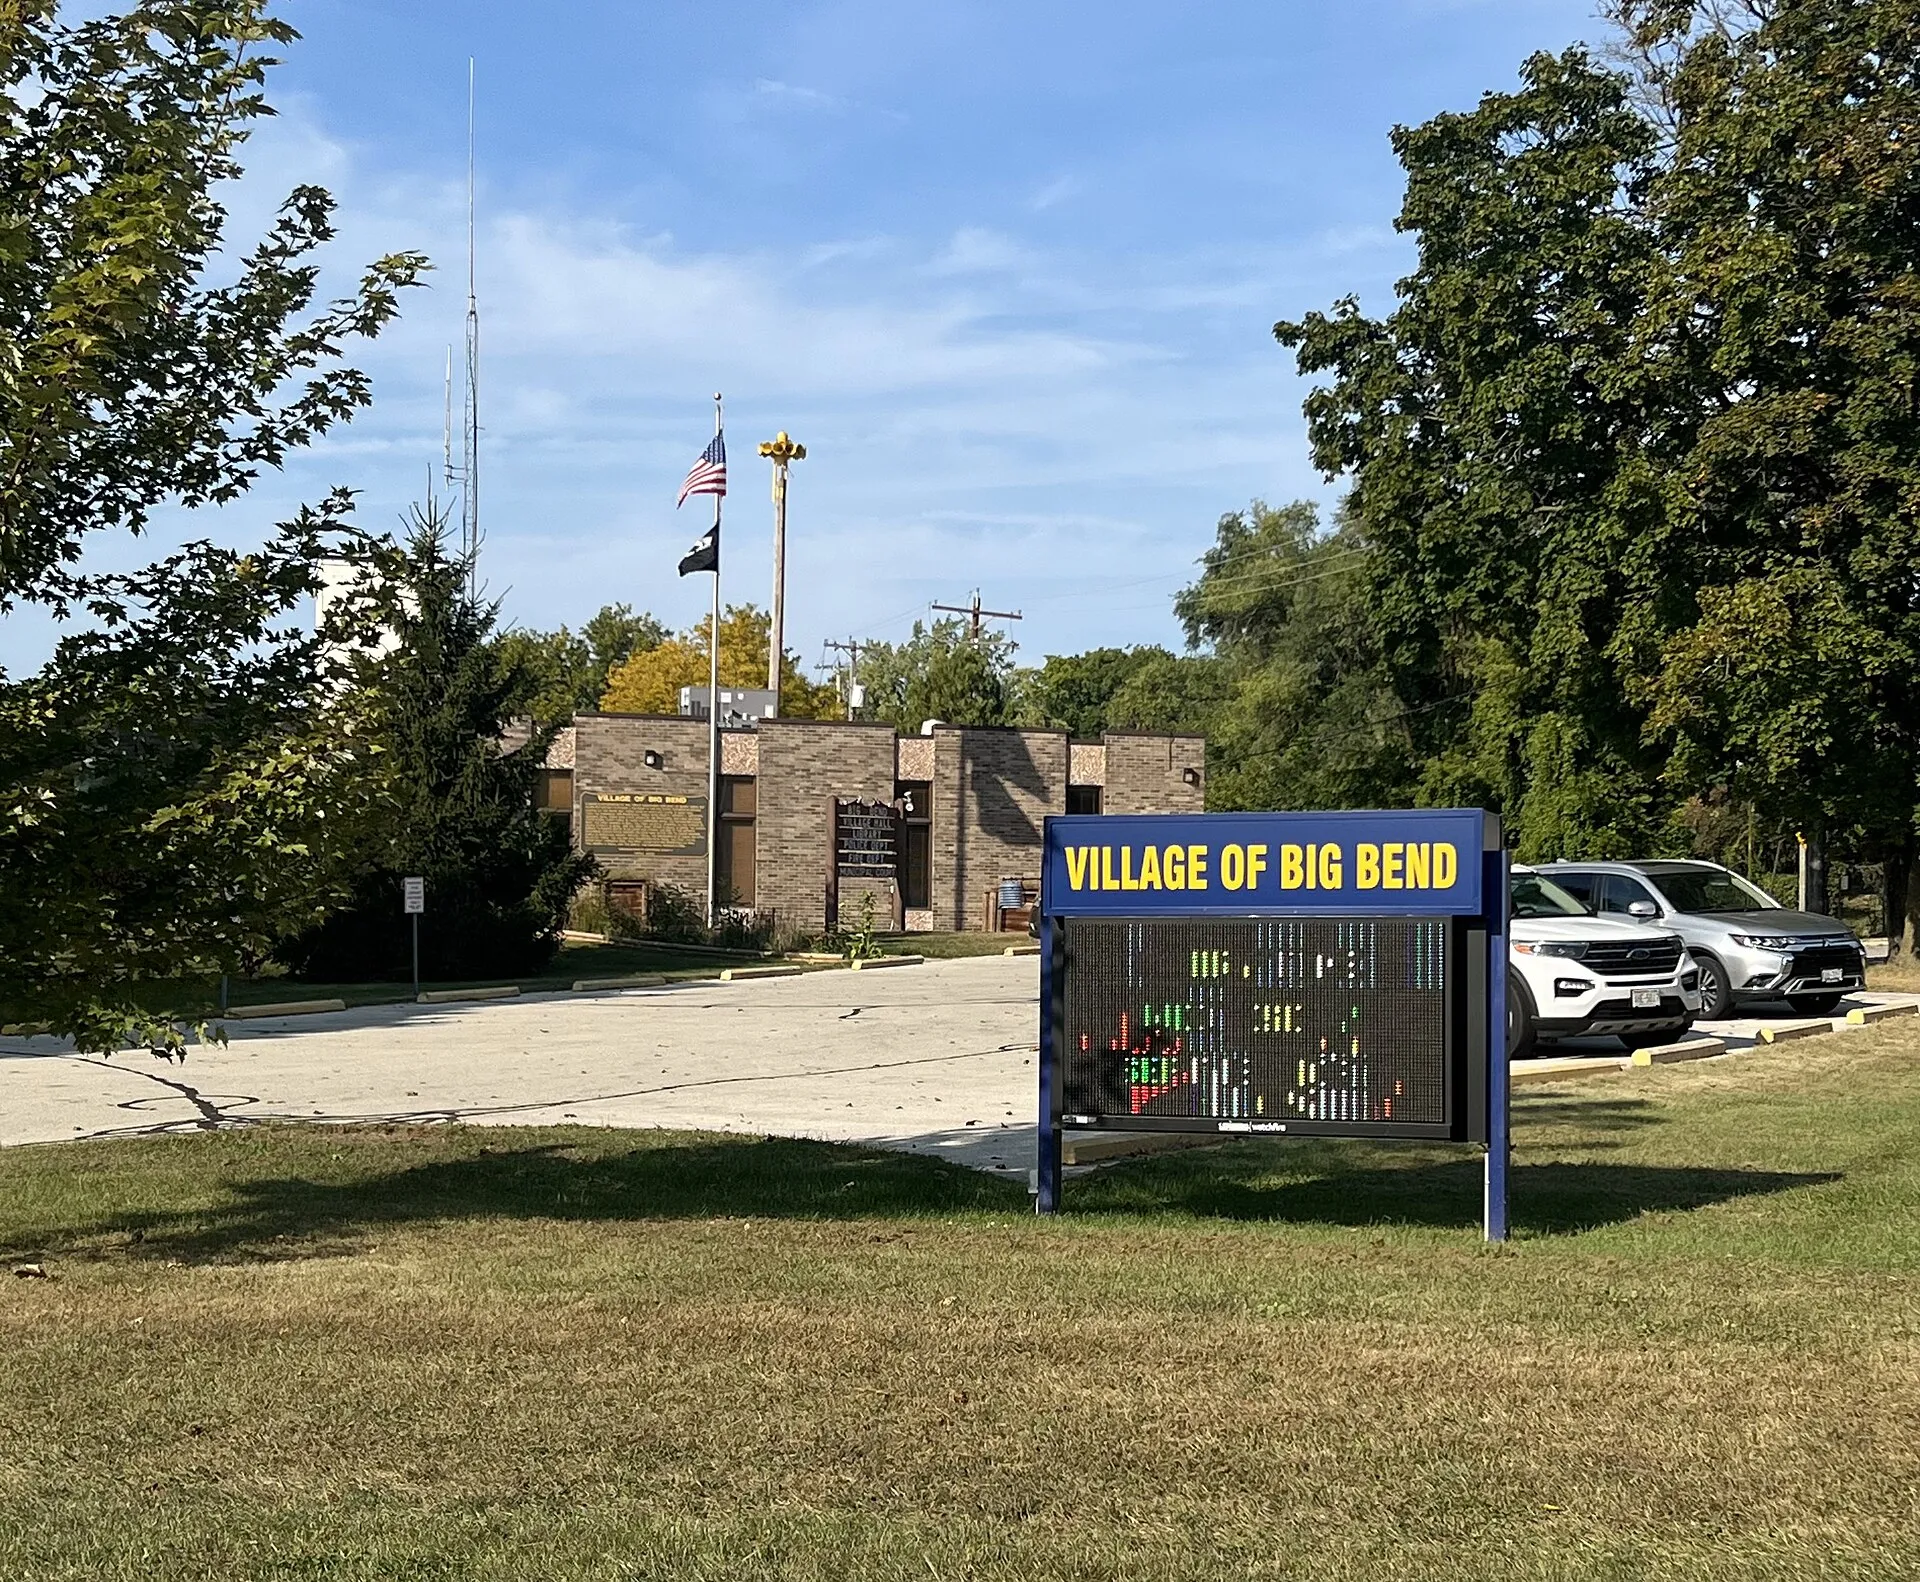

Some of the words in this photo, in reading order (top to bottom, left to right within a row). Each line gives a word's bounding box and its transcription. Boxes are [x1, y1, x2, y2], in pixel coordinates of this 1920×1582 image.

[597, 793, 631, 803] VILLAGE
[848, 805, 861, 815] BIG
[852, 829, 882, 839] LIBRARY
[1064, 844, 1208, 891] VILLAGE
[1220, 843, 1267, 891] OF
[1280, 842, 1342, 890] BIG
[1356, 842, 1458, 890] BEND
